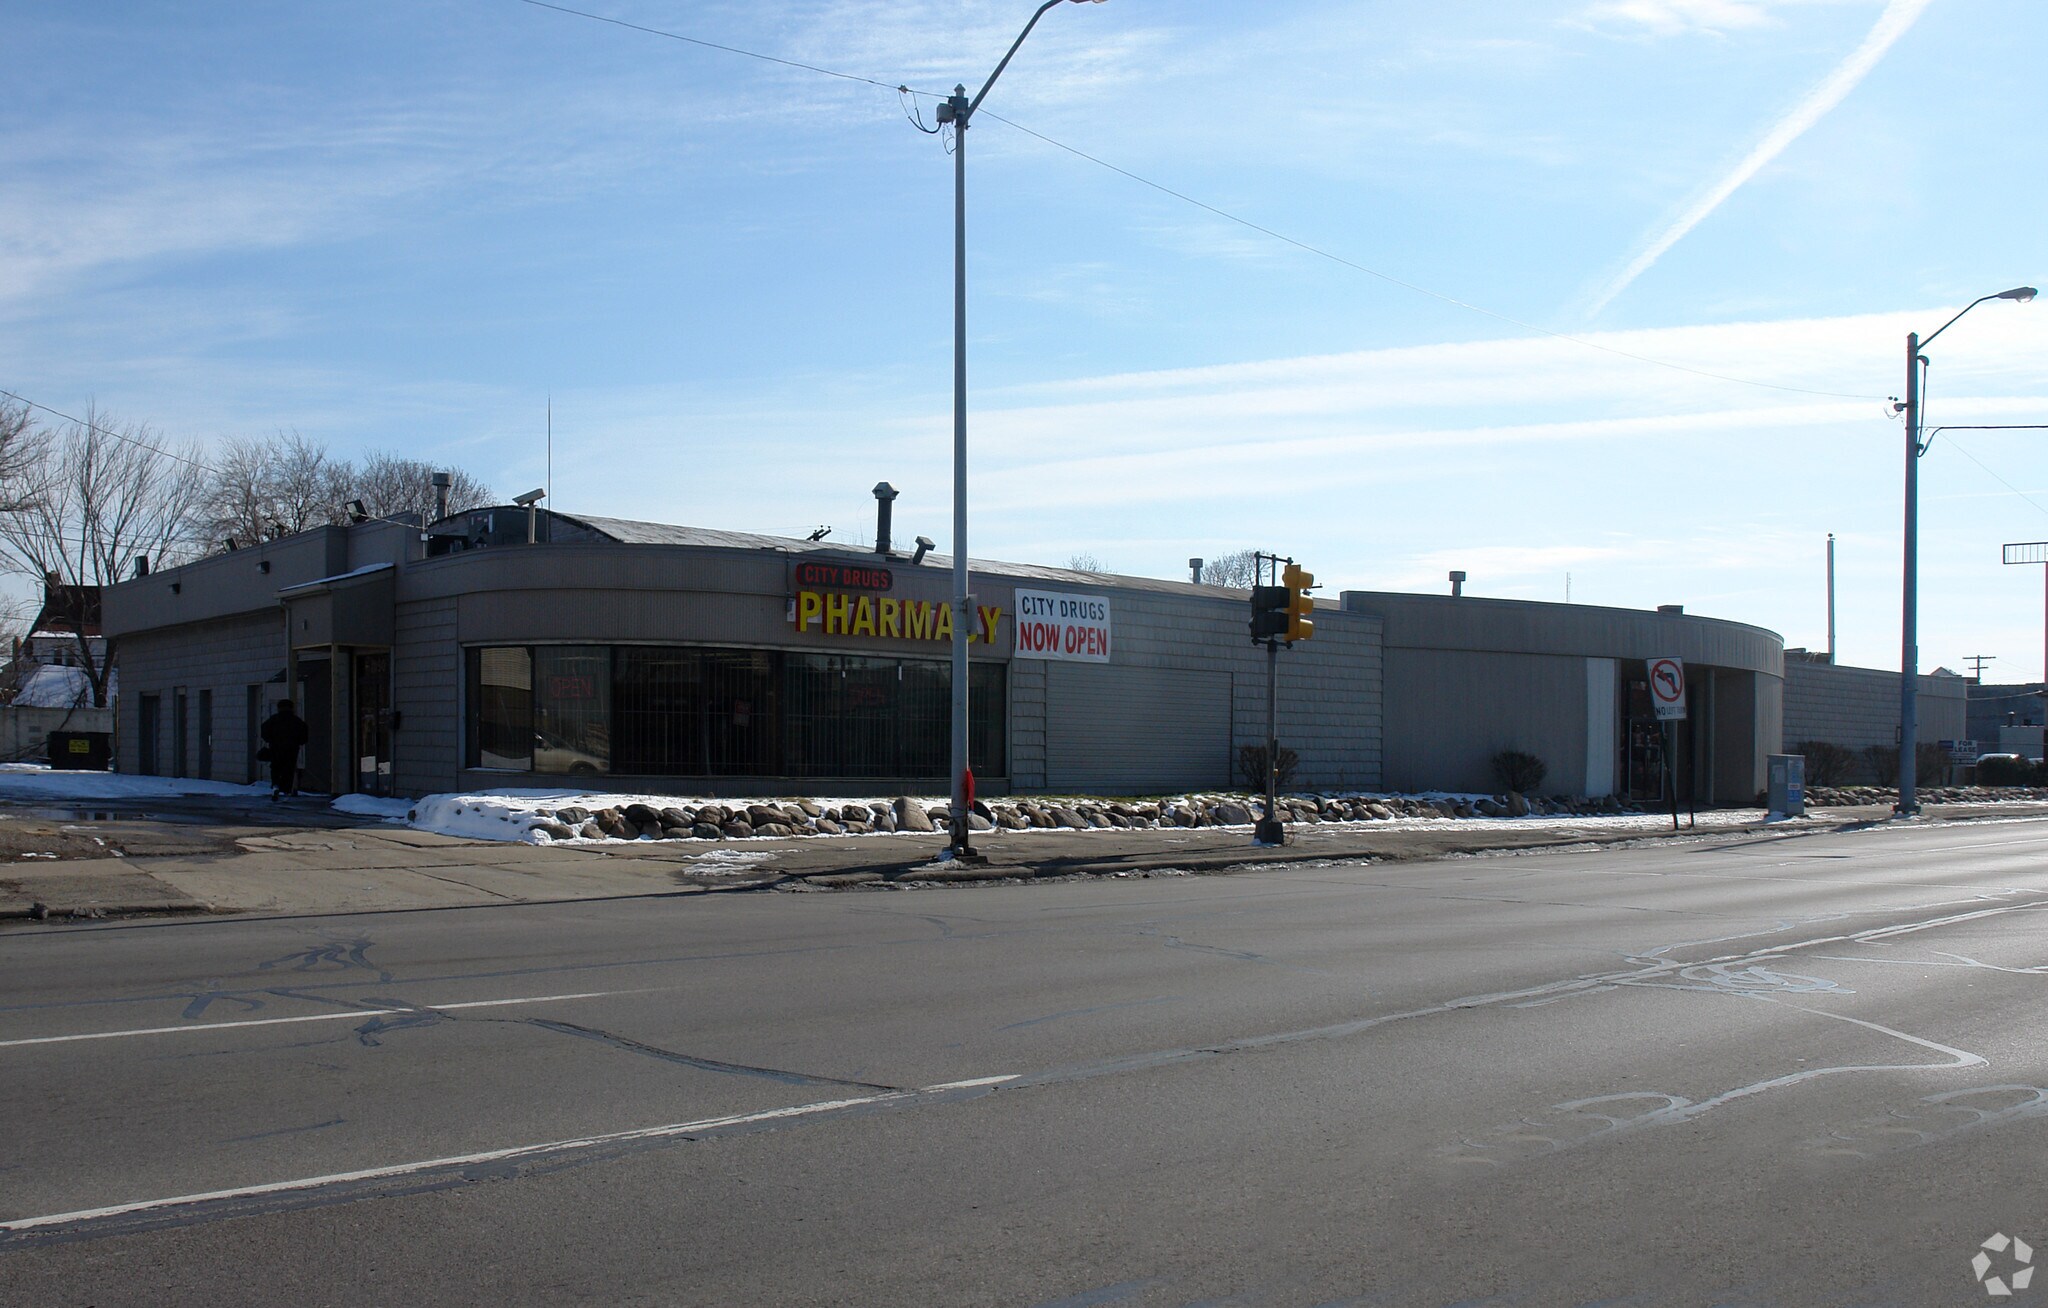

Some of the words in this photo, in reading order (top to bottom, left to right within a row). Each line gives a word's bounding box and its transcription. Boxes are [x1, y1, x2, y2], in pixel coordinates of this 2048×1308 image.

[804, 565, 837, 586] CITY
[843, 567, 889, 589] DRUGS
[796, 591, 1002, 644] PHARMAY
[1022, 596, 1054, 618] CITY
[1060, 600, 1105, 621] DRUGS
[1019, 621, 1060, 652] NOW
[1064, 625, 1107, 656] OPEN
[1656, 706, 1666, 716] NO
